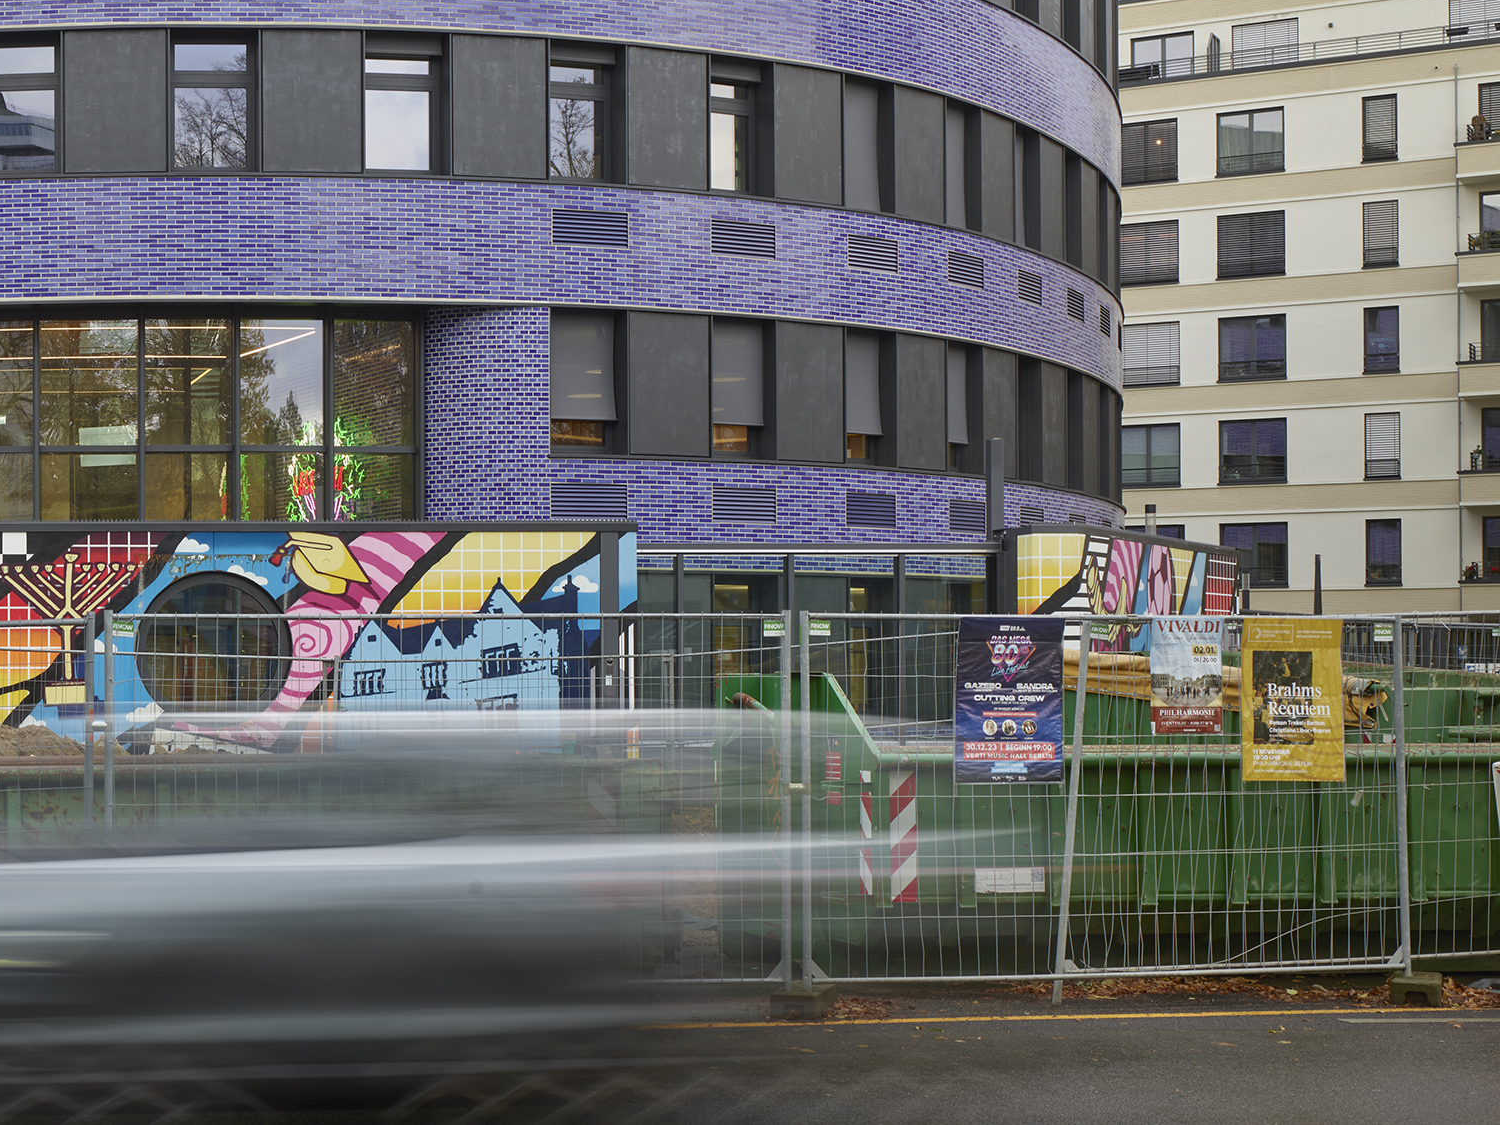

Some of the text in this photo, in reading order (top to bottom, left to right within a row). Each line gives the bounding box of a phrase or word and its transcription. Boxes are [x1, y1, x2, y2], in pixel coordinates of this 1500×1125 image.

[1157, 620, 1221, 633] VIVALDI
[990, 636, 1032, 644] DAS MEGA
[1193, 645, 1217, 655] 02.01.
[964, 682, 1003, 690] GAZEBO
[1267, 682, 1322, 697] Brahms
[974, 694, 1016, 702] CUTTING
[1267, 701, 1331, 719] Requiem
[965, 743, 998, 751] 30.12.23
[1033, 744, 1052, 752] 19:00
